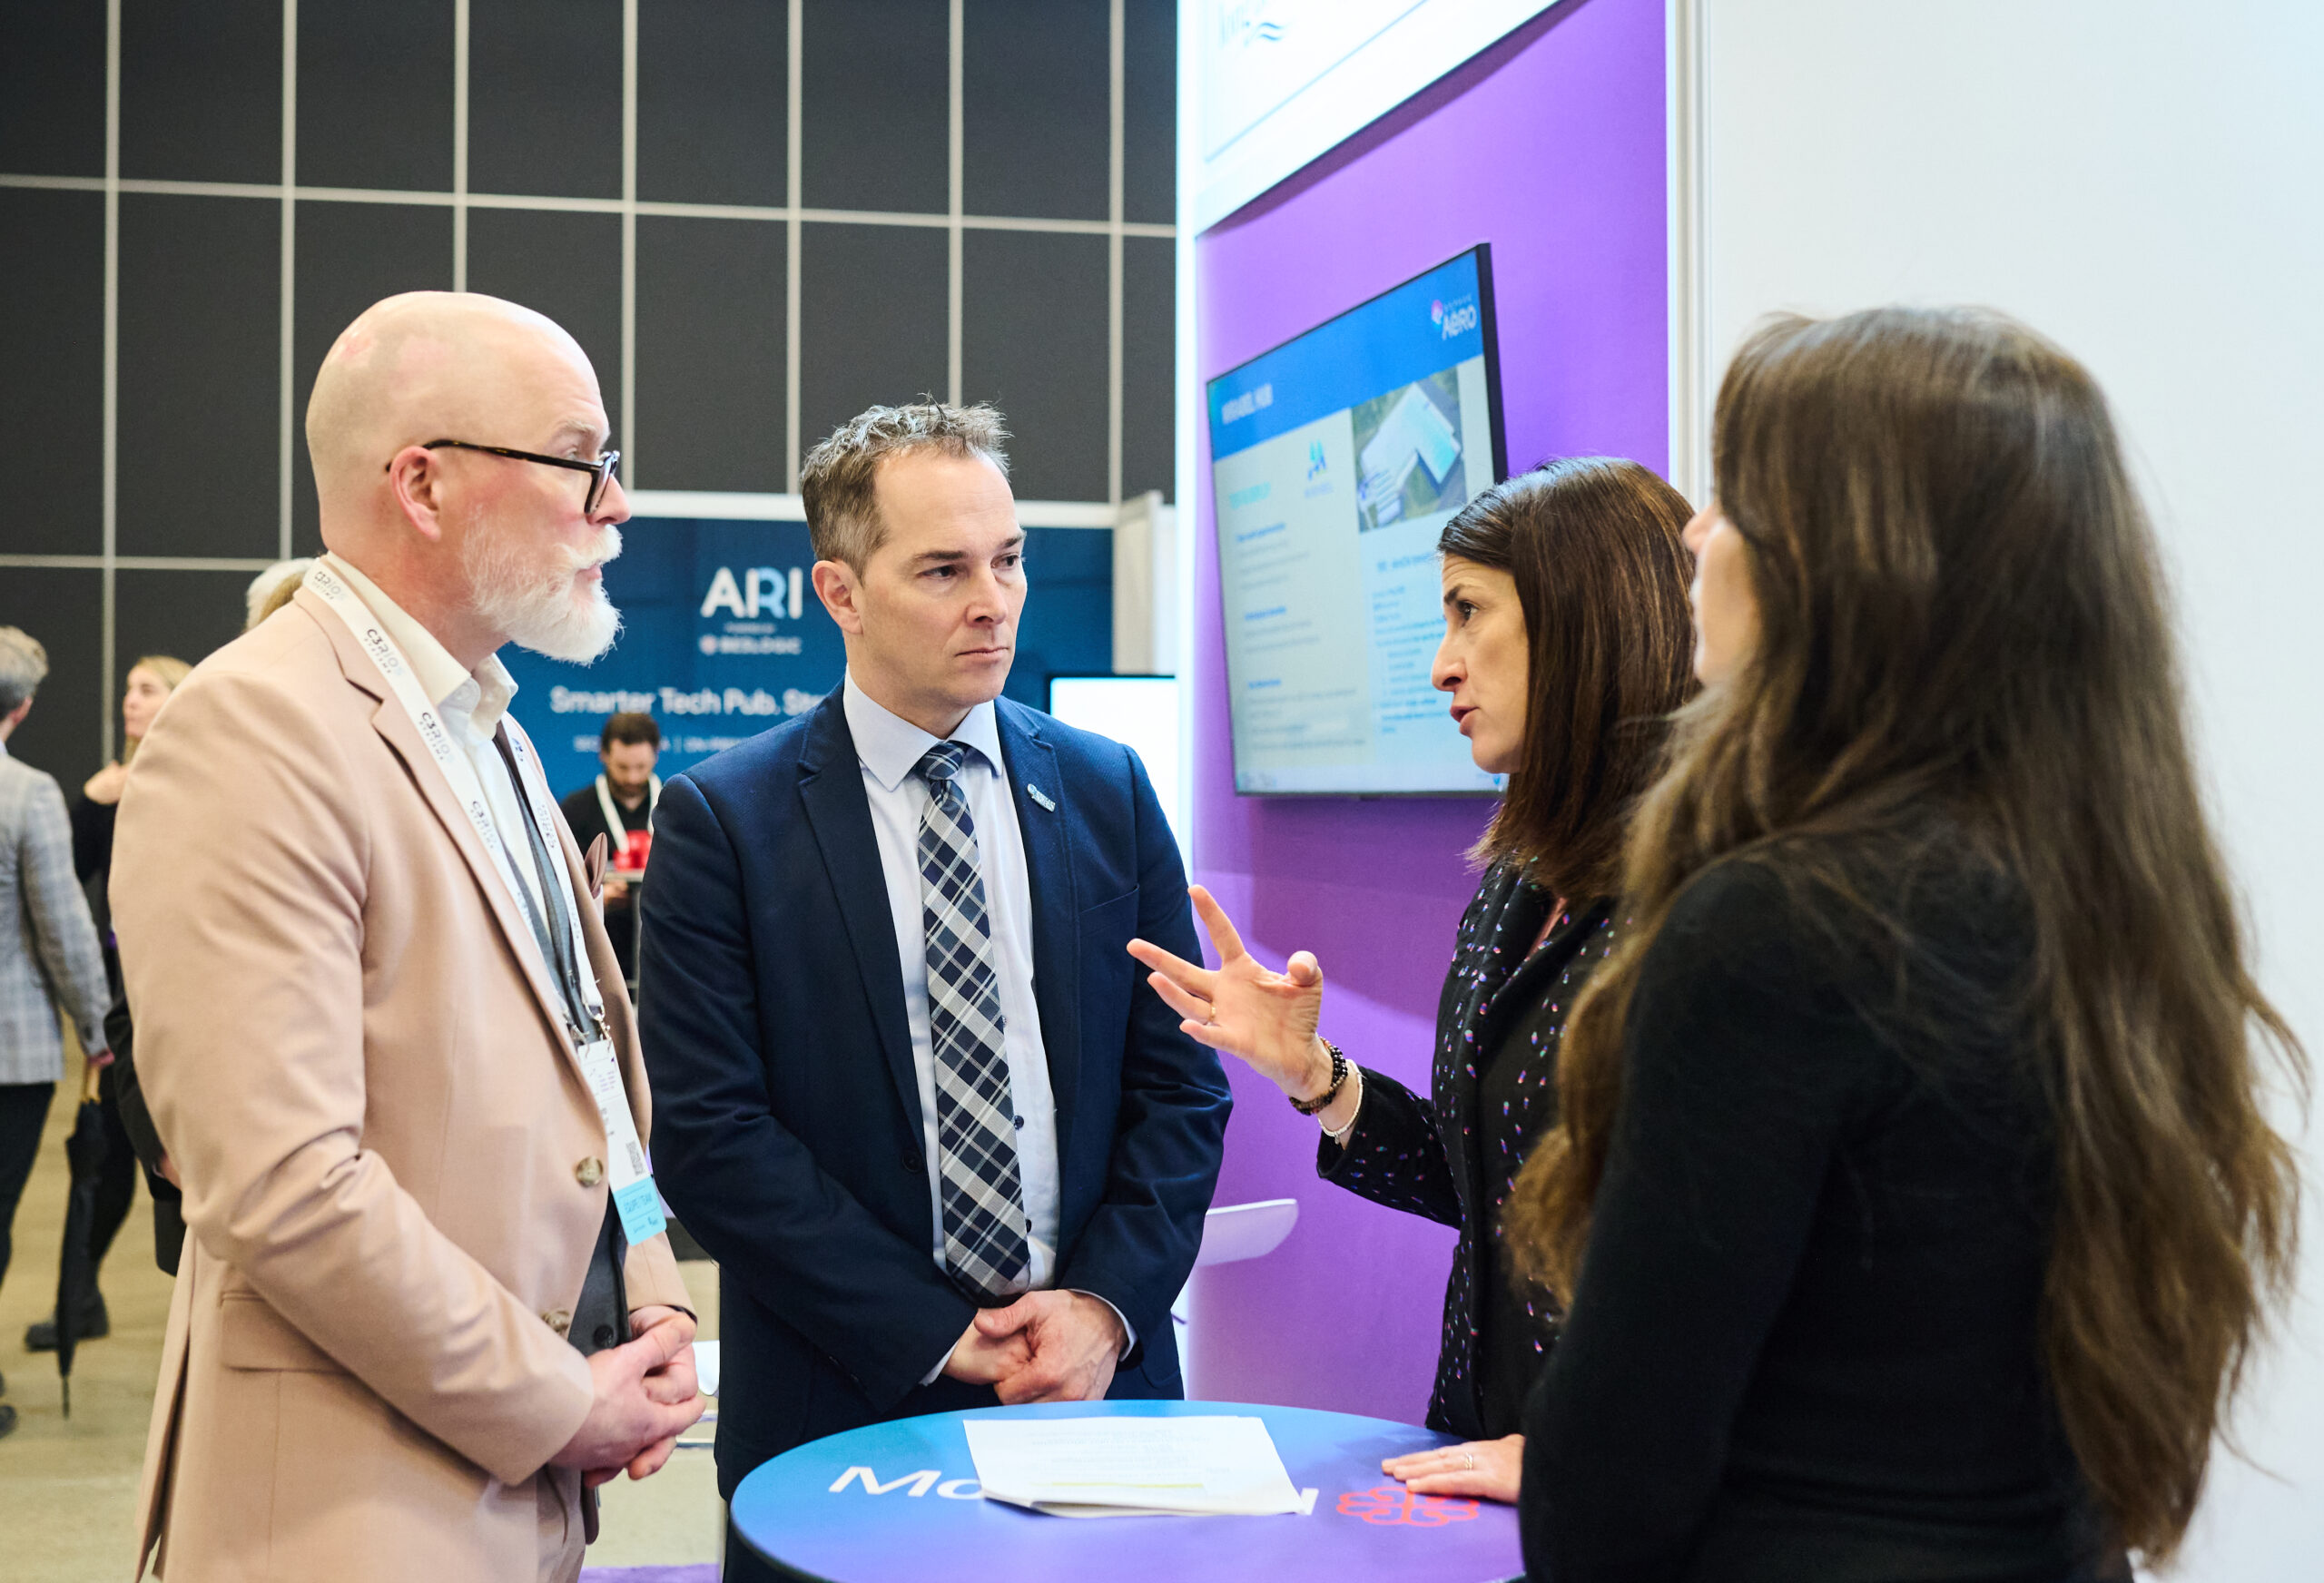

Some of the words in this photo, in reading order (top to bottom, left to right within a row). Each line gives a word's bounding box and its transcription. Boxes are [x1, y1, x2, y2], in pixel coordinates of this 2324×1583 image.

[700, 566, 803, 619] ARI
[550, 685, 655, 714] Smarter
[658, 686, 721, 714] Tech
